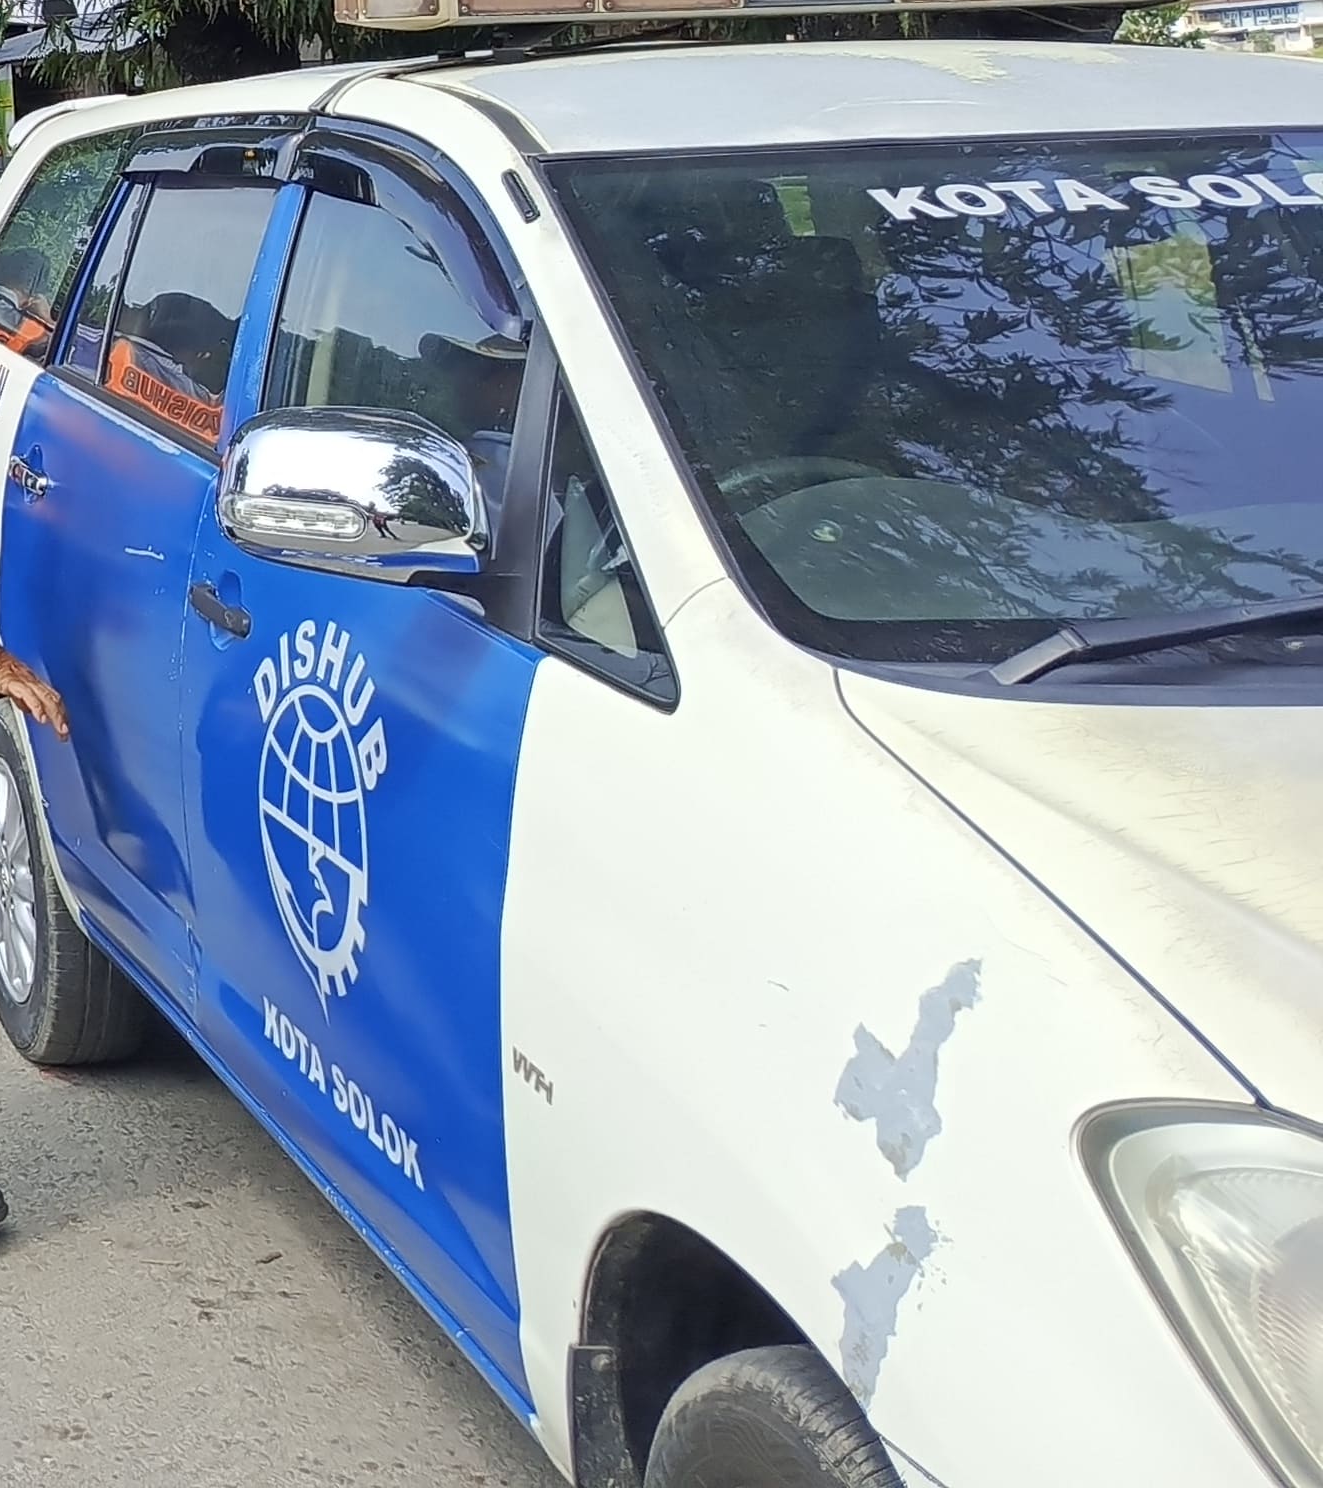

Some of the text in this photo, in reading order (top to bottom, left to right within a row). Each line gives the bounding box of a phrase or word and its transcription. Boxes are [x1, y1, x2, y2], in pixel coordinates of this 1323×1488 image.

[867, 179, 1130, 221] KOTA
[253, 619, 388, 791] DISHUB
[262, 995, 425, 1192] KOTA SOLOK
